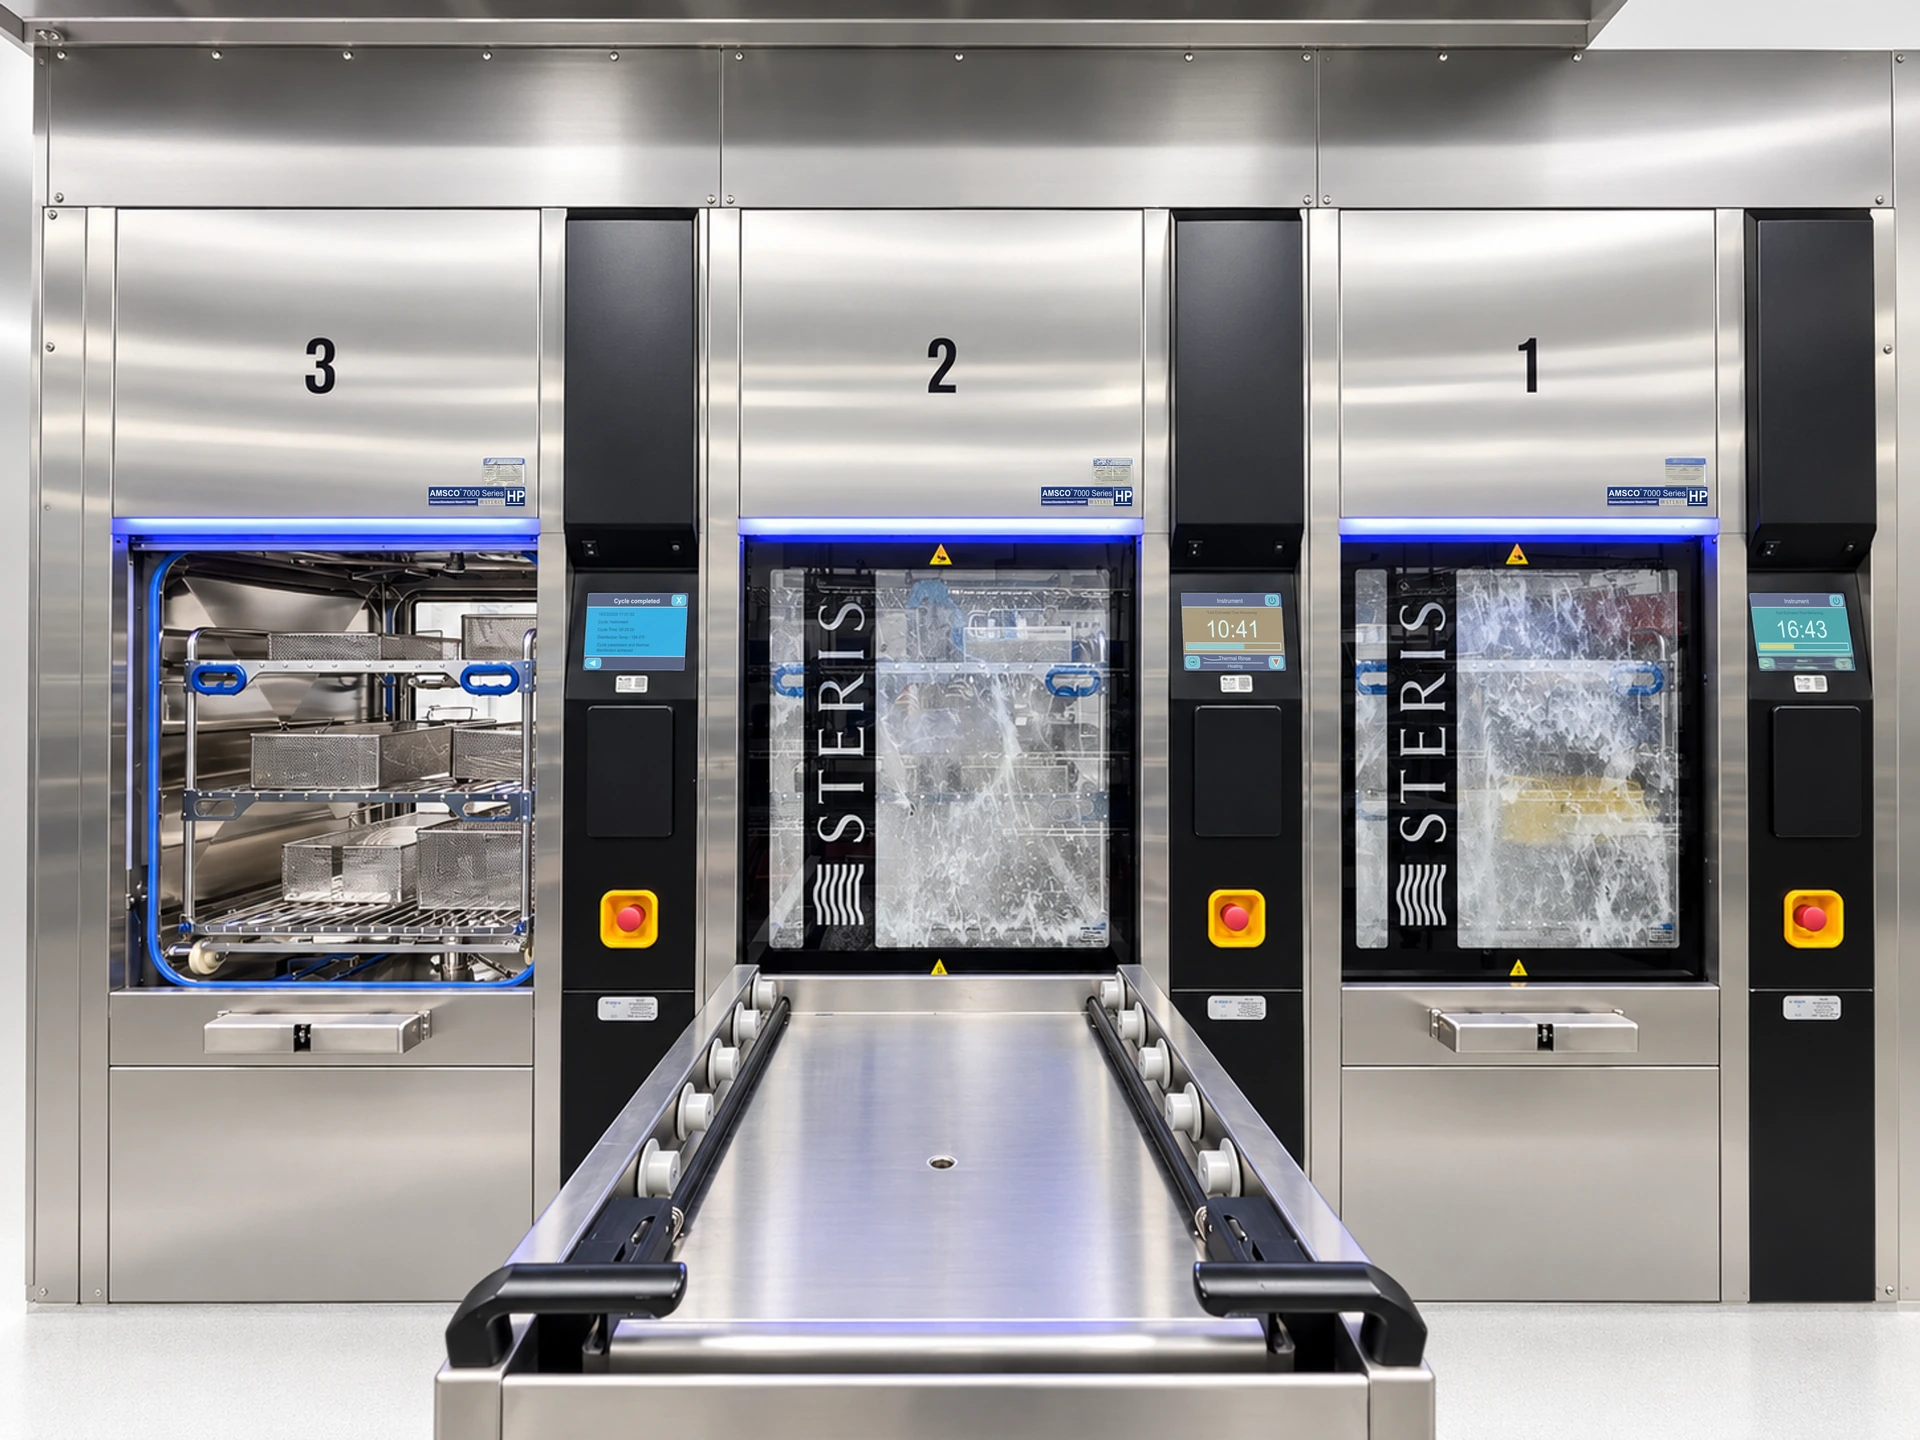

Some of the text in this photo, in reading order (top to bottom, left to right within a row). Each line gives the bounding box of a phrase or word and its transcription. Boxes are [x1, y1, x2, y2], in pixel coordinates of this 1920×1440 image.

[305, 337, 336, 394] 3
[928, 338, 957, 393] 2
[1518, 338, 1537, 393] 1
[463, 489, 480, 497] 7000
[481, 489, 504, 497] Series
[507, 490, 525, 502] HP
[1073, 489, 1090, 497] 7000
[1091, 489, 1113, 497] Series
[1115, 490, 1132, 502] HP
[1643, 489, 1660, 497] 7000
[1662, 489, 1686, 497] Series
[1689, 490, 1708, 502] HP
[1207, 619, 1257, 638] 10:41
[1777, 620, 1828, 638] 16:43
[817, 602, 865, 843] STERIS
[1399, 602, 1447, 843] STERIS
